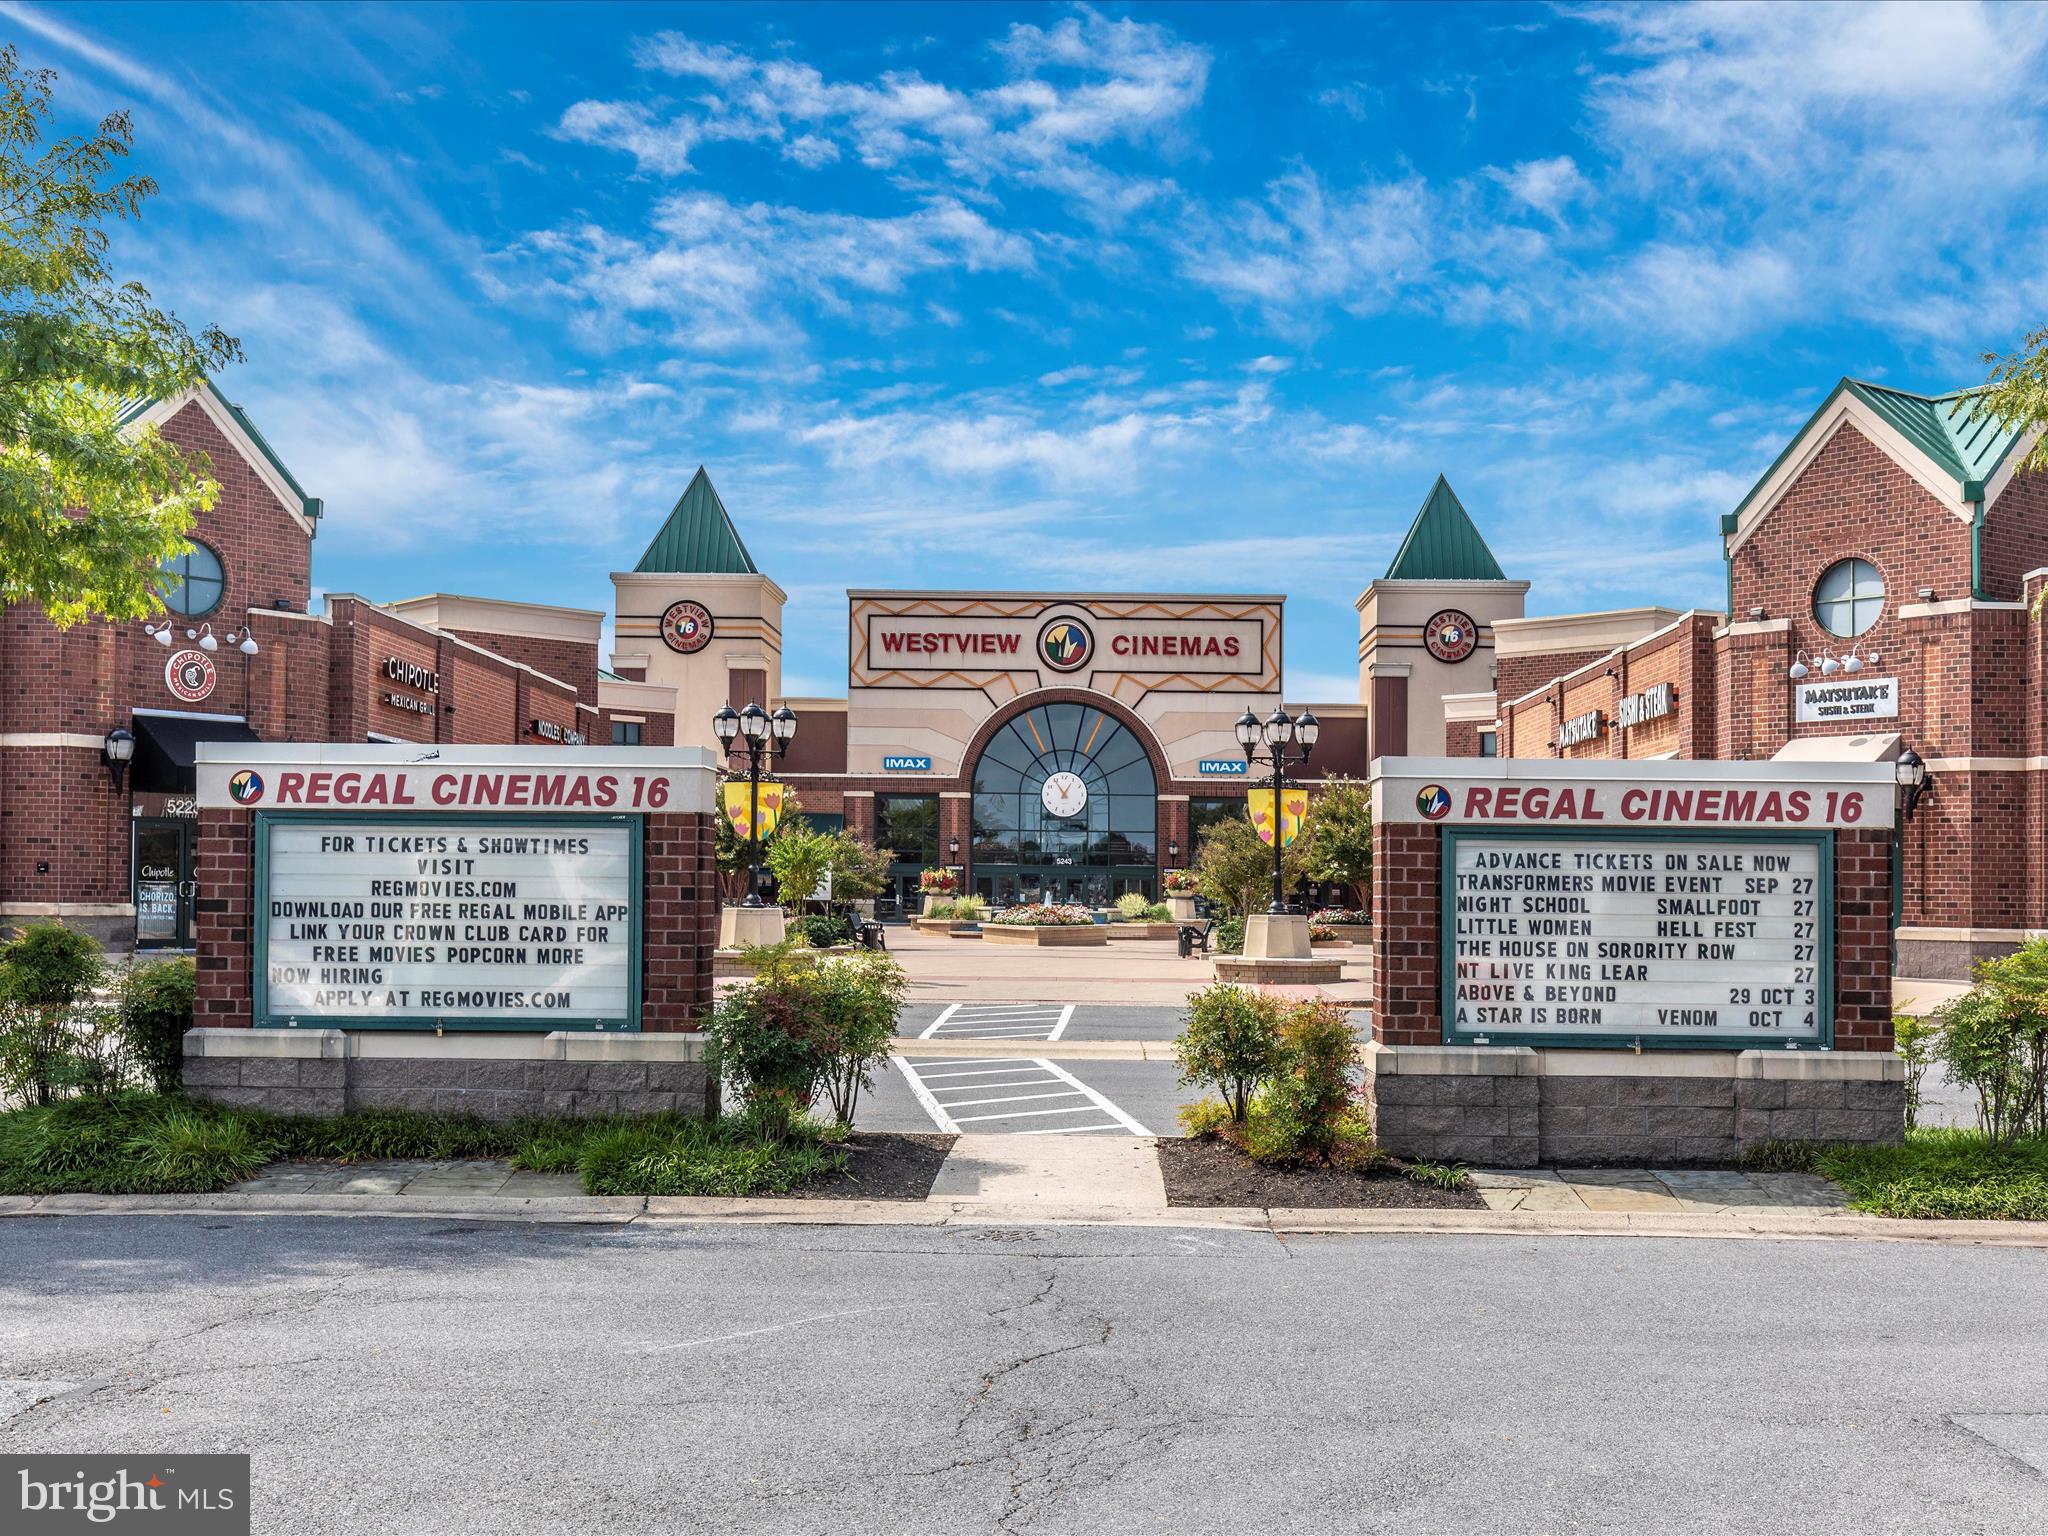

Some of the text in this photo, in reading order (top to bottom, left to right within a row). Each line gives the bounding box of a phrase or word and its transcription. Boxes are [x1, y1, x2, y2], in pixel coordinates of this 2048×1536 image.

[665, 605, 709, 628] WESTVIEW
[1428, 614, 1473, 637] WESTVIEW
[680, 621, 695, 634] 16
[1445, 630, 1459, 642] 16
[667, 632, 707, 649] CINEMAS
[881, 632, 1240, 657] WESTVIEW CINEMAS
[1430, 641, 1472, 658] CINEMAS
[173, 653, 213, 674] CHIPOTLE
[389, 657, 439, 693] CHIPOTLE
[391, 693, 418, 711] MEXICAN
[1804, 684, 1889, 704] MATSUTAKE
[1620, 682, 1668, 728] SUSHI & STEAK
[1818, 703, 1875, 716] SUSHI & STEAK
[885, 758, 927, 768] IMAX
[1201, 762, 1243, 772] IMAX
[277, 772, 670, 808] REGAL CINEMAS 16
[1463, 787, 1864, 823] REGAL CINEMAS 16
[322, 836, 588, 854] FOR TICKETS & SHOWTIMES
[418, 859, 474, 875] VISIT
[1476, 852, 1790, 872] ADVANCE TICKETS ON SALE NOW
[142, 865, 174, 880] Chipotle
[372, 881, 516, 898] REGMOVIES.COM
[1457, 874, 1813, 894] TRANSFORMERS MOVIE EVENT SEP 27
[272, 902, 627, 920] DOWNLOAD OUR FREE REGAL MOBILE APP
[1457, 896, 1814, 916] NIGHT SCHOOL SMALLFOOT 27
[291, 924, 608, 942] LINK YOUR CROWN CLUB CARD FOR
[1457, 918, 1814, 938] LITTLE WOMEN HELL FEST 27
[313, 946, 583, 964] FREE MOVIES POPCORN MORE
[1457, 940, 1814, 961] THE HOUSE ON SORORITY ROW 27
[272, 968, 382, 984] NOW HIRING
[1457, 963, 1814, 983] NT LIVE KING LEAR 27
[314, 990, 570, 1008] APPLY AT REGMOVIES.COM
[1457, 984, 1815, 1005] ABOVE & BEYOND 29 OCT 3
[1457, 1007, 1814, 1027] A STAR IS BORN VENOM OCT 4
